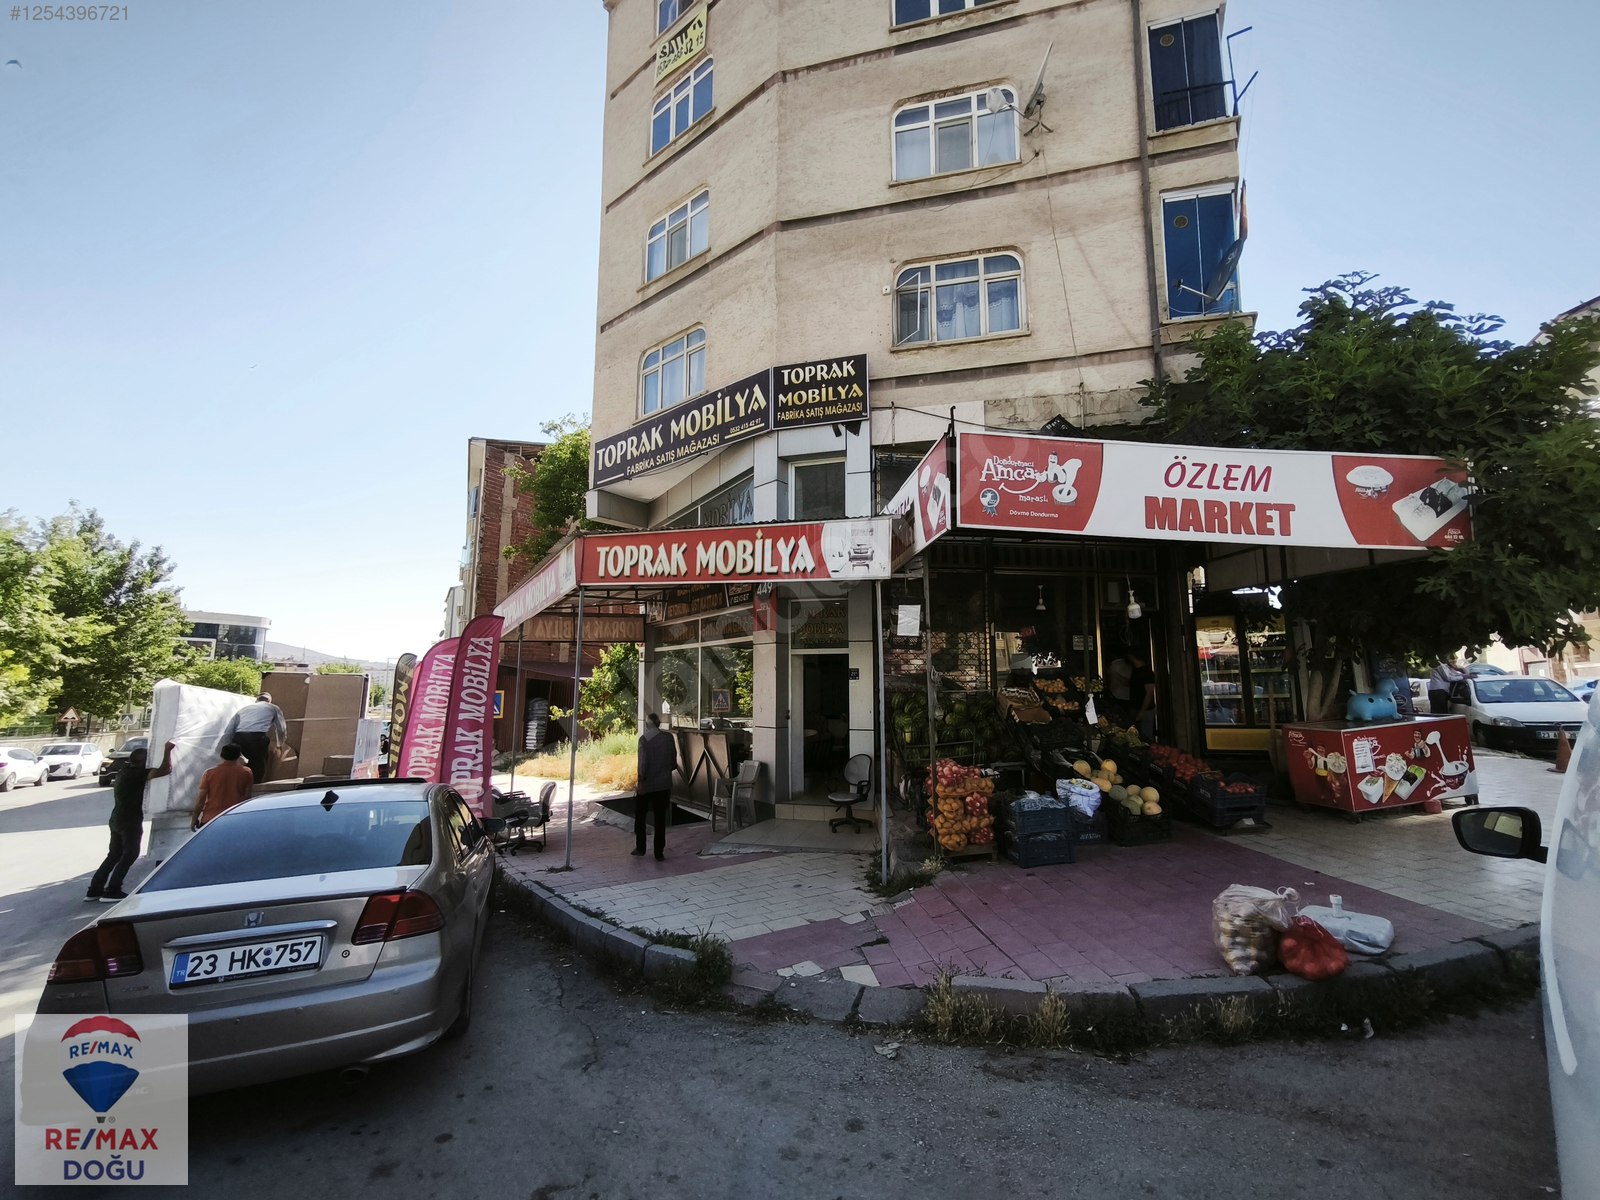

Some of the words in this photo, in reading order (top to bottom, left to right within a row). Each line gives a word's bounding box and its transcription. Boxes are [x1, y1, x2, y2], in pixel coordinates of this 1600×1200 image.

[781, 359, 856, 386] TOPRAK
[777, 409, 805, 421] FABRİKA
[806, 405, 825, 419] SATIŞ
[825, 402, 863, 415] MAĞAZASI
[778, 383, 863, 407] MOBİLYA
[597, 423, 664, 471] TOPRAK
[670, 383, 767, 444] MOBİLYA
[626, 458, 655, 476] FABRİKA
[656, 450, 676, 464] SATIŞ
[676, 433, 720, 458] MAĞAZASI
[980, 458, 1036, 482] Amca
[1164, 455, 1273, 493] ÖZLEM
[1144, 495, 1296, 537] MARKET
[596, 541, 688, 578] TOPRAK
[696, 528, 816, 576] MOBİLYA
[420, 654, 455, 721] MOBİLYA
[458, 636, 494, 723] MOBİLYA
[407, 725, 444, 784] OPRAK
[176, 969, 186, 977] TR
[187, 953, 218, 978] 23
[228, 947, 264, 972] HK
[274, 940, 317, 966] 757
